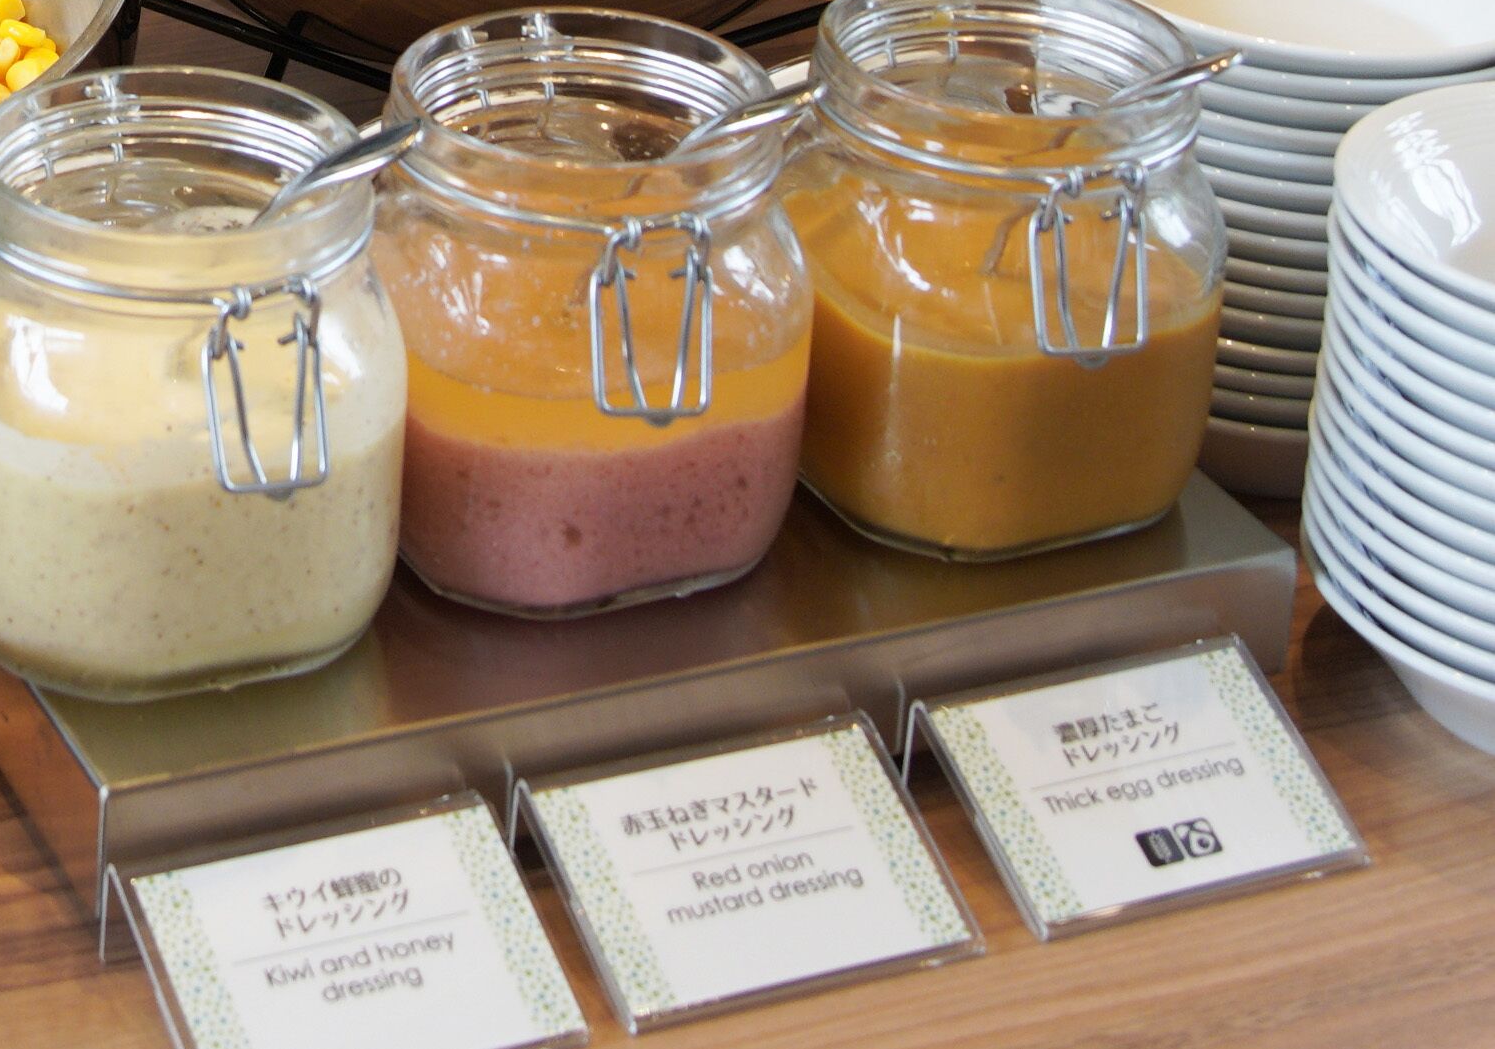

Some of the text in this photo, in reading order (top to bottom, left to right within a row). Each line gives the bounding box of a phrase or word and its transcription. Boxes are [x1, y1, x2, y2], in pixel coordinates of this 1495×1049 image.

[1061, 721, 1180, 767] ドレッシング
[1042, 756, 1245, 815] Thick egg dressing
[669, 805, 796, 852] ドレッシング
[666, 866, 865, 925] mustard dressing
[691, 851, 814, 891] Red onion
[275, 888, 409, 939] ドレッシング
[263, 931, 455, 987] Kiwi and honey
[321, 966, 424, 1003] dressing
